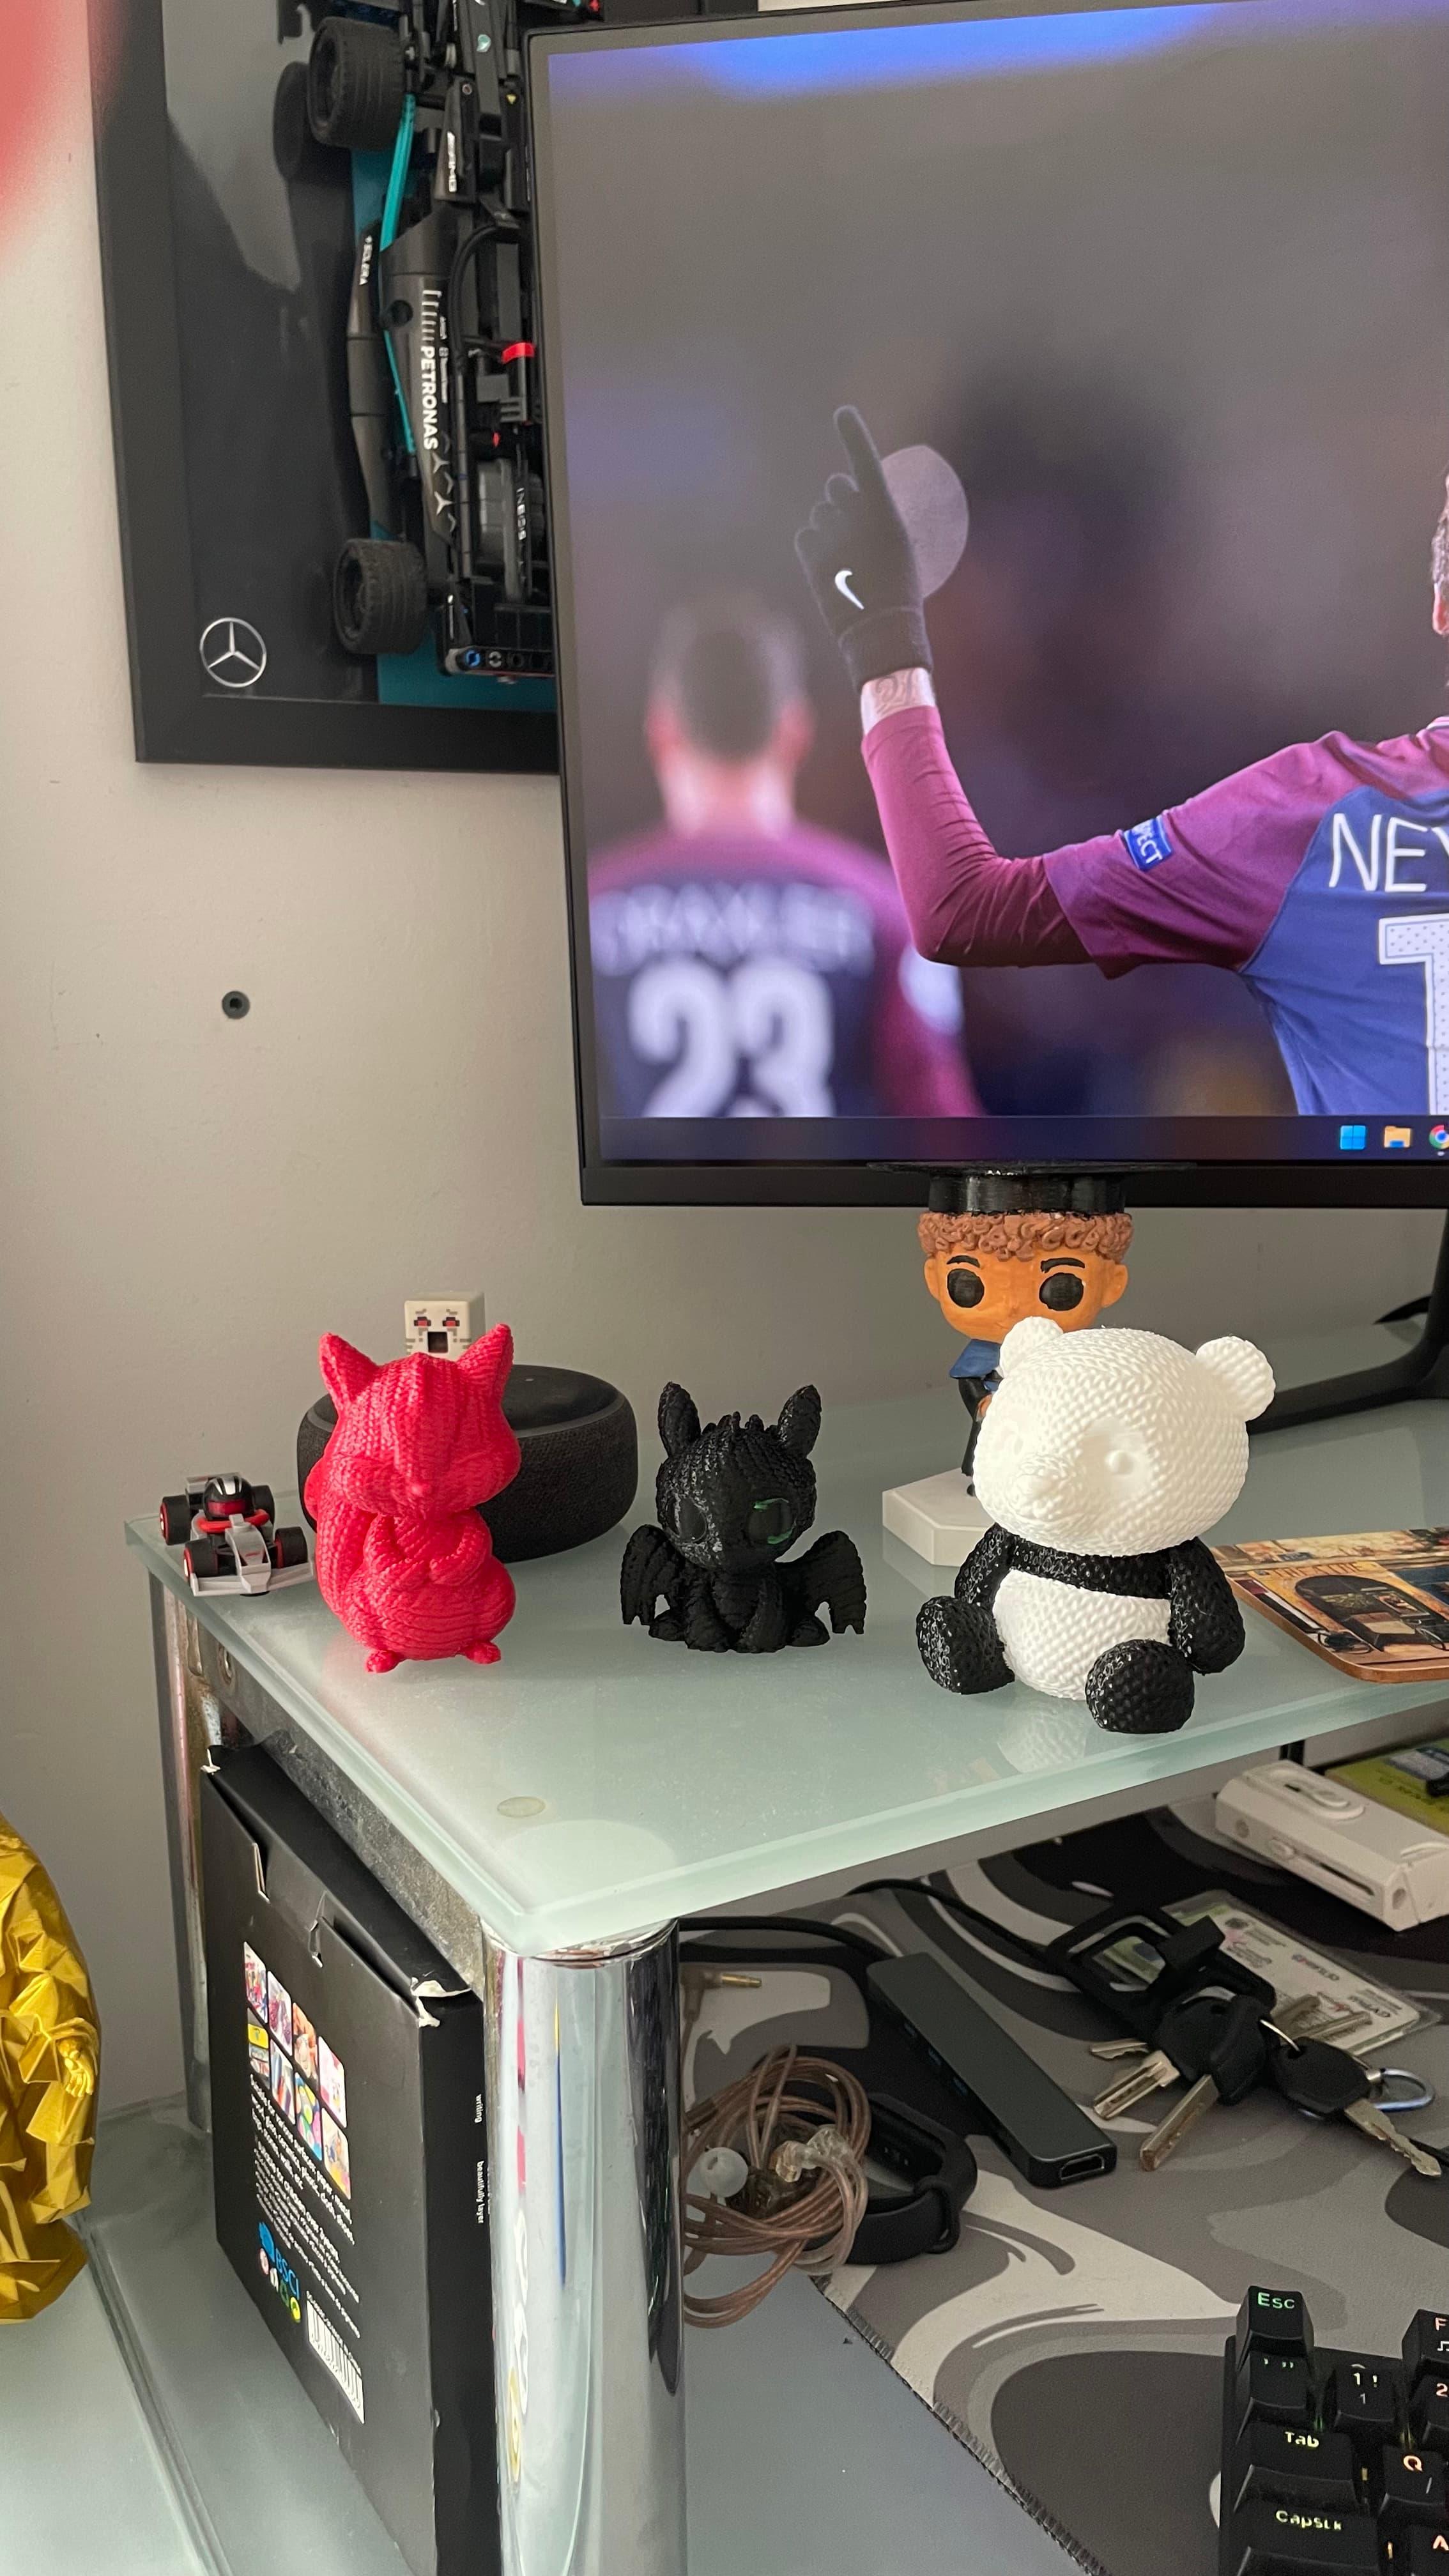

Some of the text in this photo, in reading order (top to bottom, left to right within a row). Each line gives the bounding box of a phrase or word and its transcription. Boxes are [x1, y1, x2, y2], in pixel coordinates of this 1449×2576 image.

[420, 346, 439, 450] PETRONAS
[475, 2094, 484, 2123] writing
[476, 2160, 486, 2223] beautifully layer
[275, 2248, 300, 2300] BSCI
[1257, 2291, 1296, 2310] Esc
[1435, 2317, 1449, 2331] F
[1436, 2382, 1449, 2398] 2
[1285, 2430, 1320, 2448] Tab
[1403, 2455, 1423, 2472] Q
